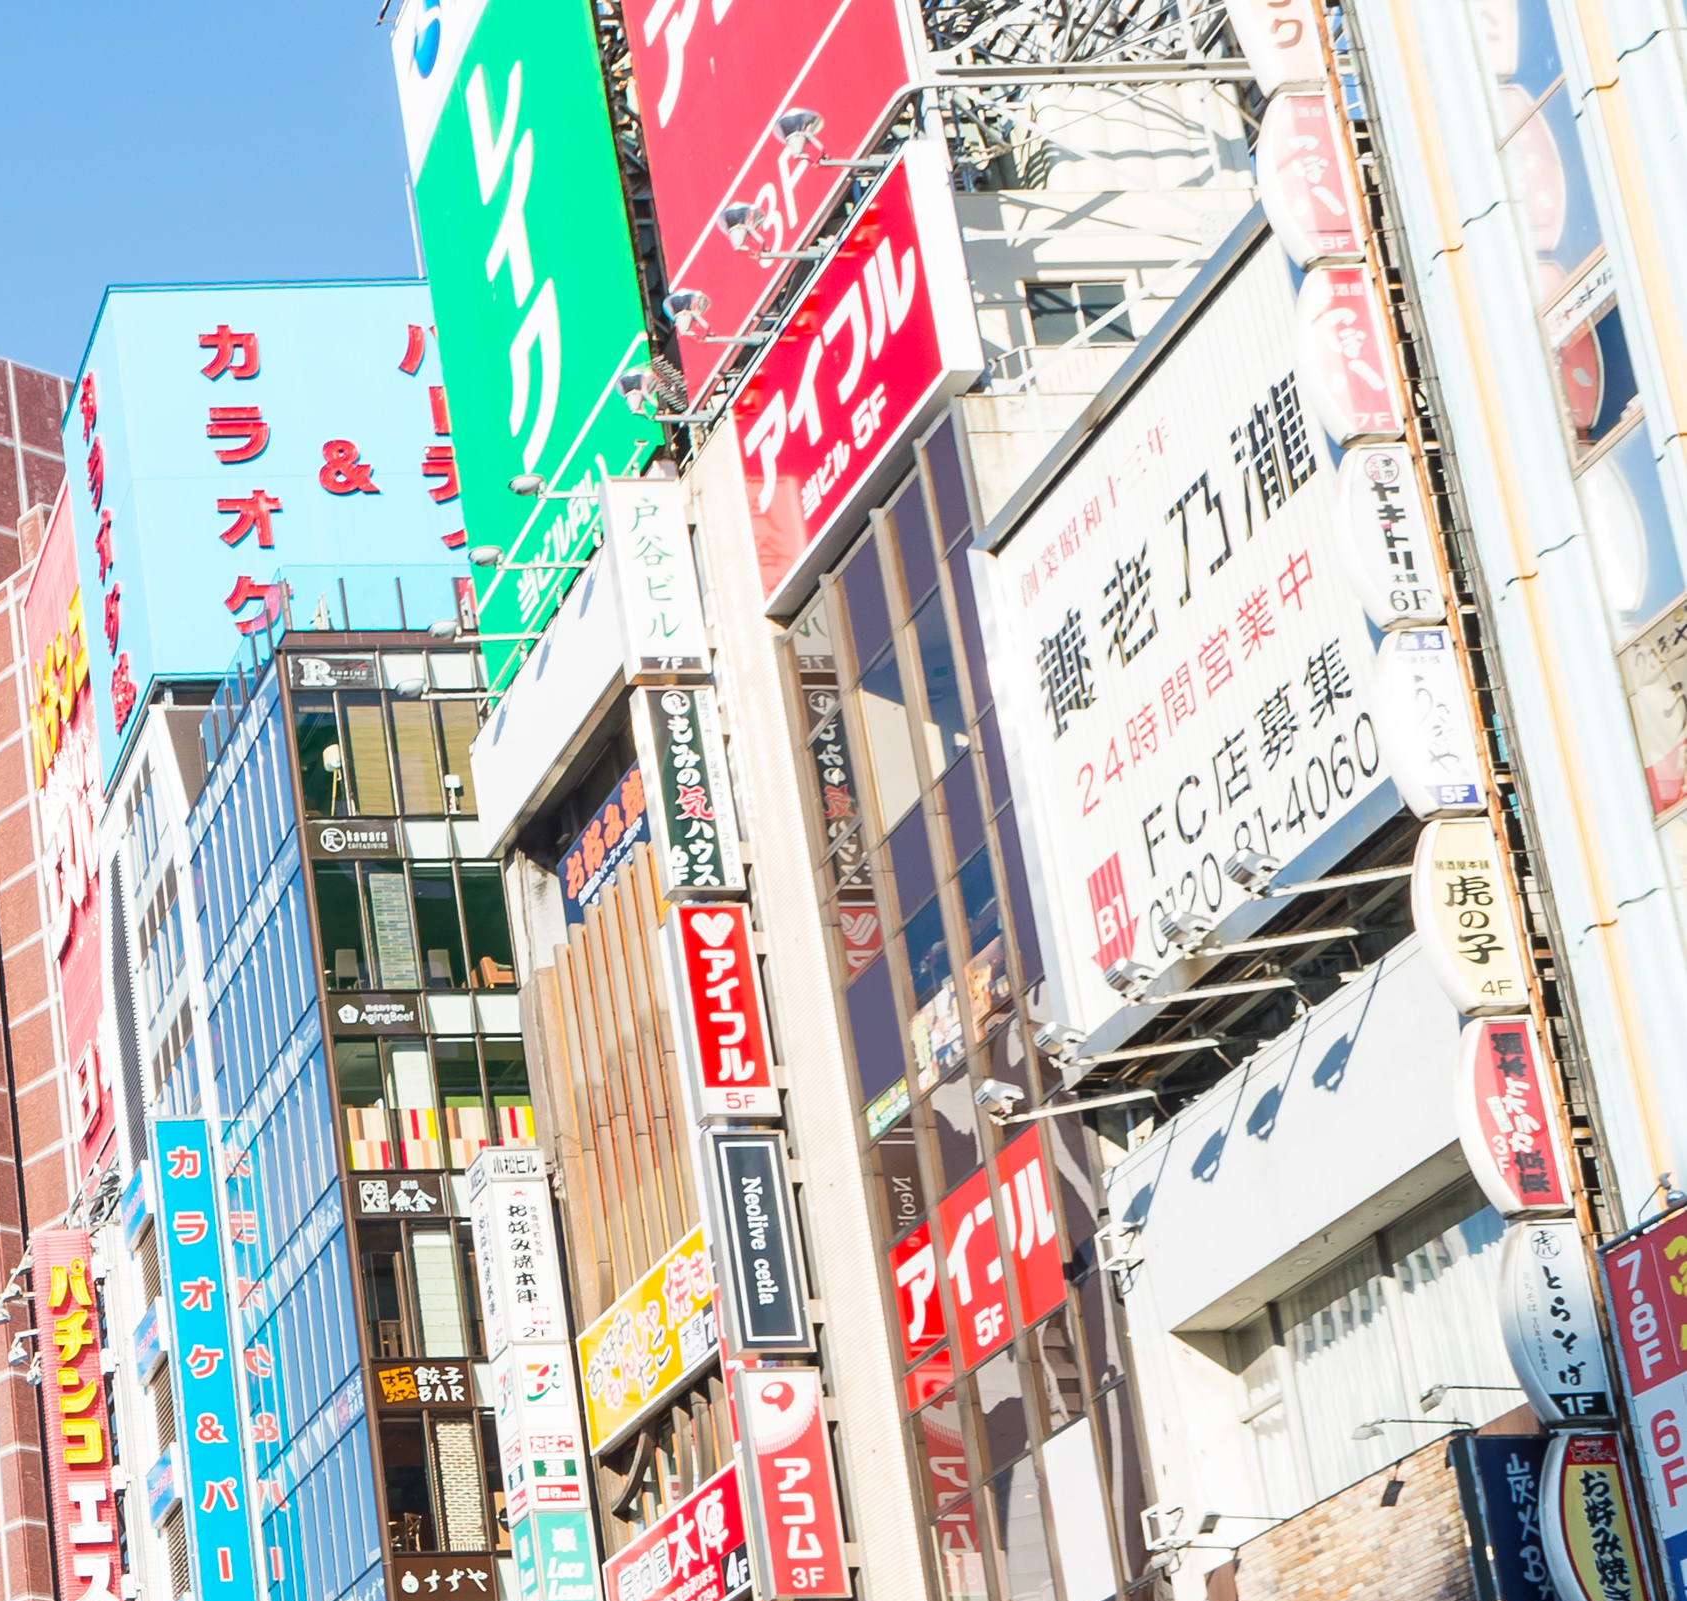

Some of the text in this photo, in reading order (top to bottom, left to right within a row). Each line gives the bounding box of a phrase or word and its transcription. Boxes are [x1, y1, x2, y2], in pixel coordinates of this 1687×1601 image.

[465, 60, 560, 475] レイク
[742, 235, 915, 514] アイフル
[198, 324, 291, 635] カラオケ
[320, 439, 381, 495] &
[799, 440, 852, 520] 当ビル
[1020, 417, 1171, 605] 創業昭和十三年
[628, 495, 685, 641] 戸谷ビル
[1035, 369, 1318, 741] 養老乃瀧
[1370, 481, 1415, 572] ヤキトリ
[298, 657, 338, 687] R
[1077, 548, 1315, 818] 24時間営業中
[667, 717, 721, 887] もみの気ハウス
[1140, 637, 1355, 880] FC店募集
[346, 829, 389, 843] kawara
[1434, 859, 1491, 872] 居酒屋本舗
[1443, 875, 1505, 966] 虎の子
[359, 1011, 415, 1024] AgingBeef
[699, 948, 755, 1083] アイフル
[389, 1189, 438, 1213] 魚金
[492, 1155, 538, 1175] 小松ビル
[741, 1175, 771, 1251] Neolive
[896, 1156, 1056, 1343] アイフル
[661, 1249, 710, 1332] 焼き
[1542, 1264, 1587, 1387] とらそば
[48, 1258, 104, 1465] パチンコ
[413, 1366, 465, 1387] 餃子
[418, 1385, 465, 1403] BAR
[586, 1308, 632, 1398] お好み
[529, 1436, 575, 1453] たばこ
[537, 1486, 580, 1501] 銀行ATM
[772, 1456, 824, 1560] アコム
[791, 1566, 826, 1590] 3F
